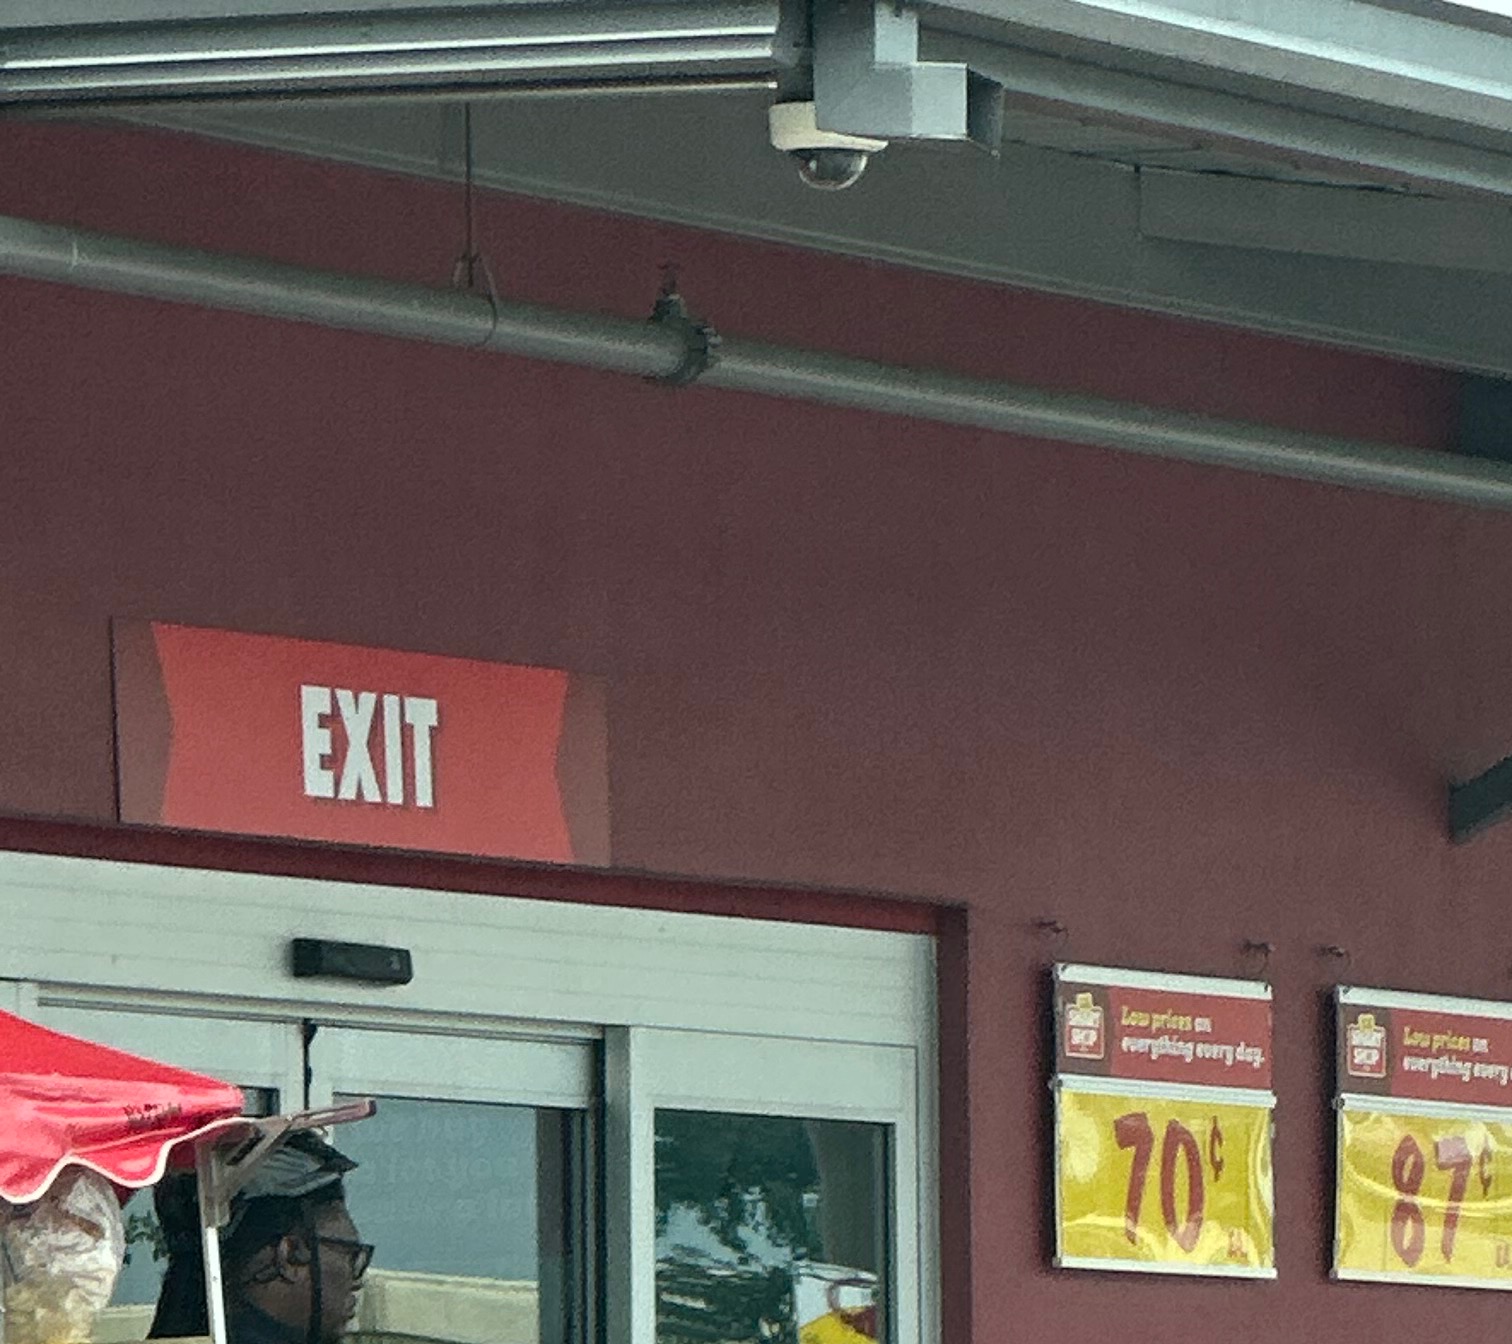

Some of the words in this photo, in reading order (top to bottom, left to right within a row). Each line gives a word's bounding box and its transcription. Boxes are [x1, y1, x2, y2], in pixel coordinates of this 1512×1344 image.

[301, 684, 438, 808] EXIT
[1121, 1006, 1149, 1026] Low
[1152, 1009, 1192, 1033] prices
[1121, 1036, 1194, 1063] everything
[1196, 1044, 1234, 1066] every
[1403, 1026, 1430, 1047] Low
[1432, 1030, 1470, 1053] prices
[1402, 1055, 1471, 1082] everything
[1473, 1063, 1508, 1086] every
[1114, 1111, 1225, 1253] 70¢
[1390, 1134, 1493, 1268] 87¢
